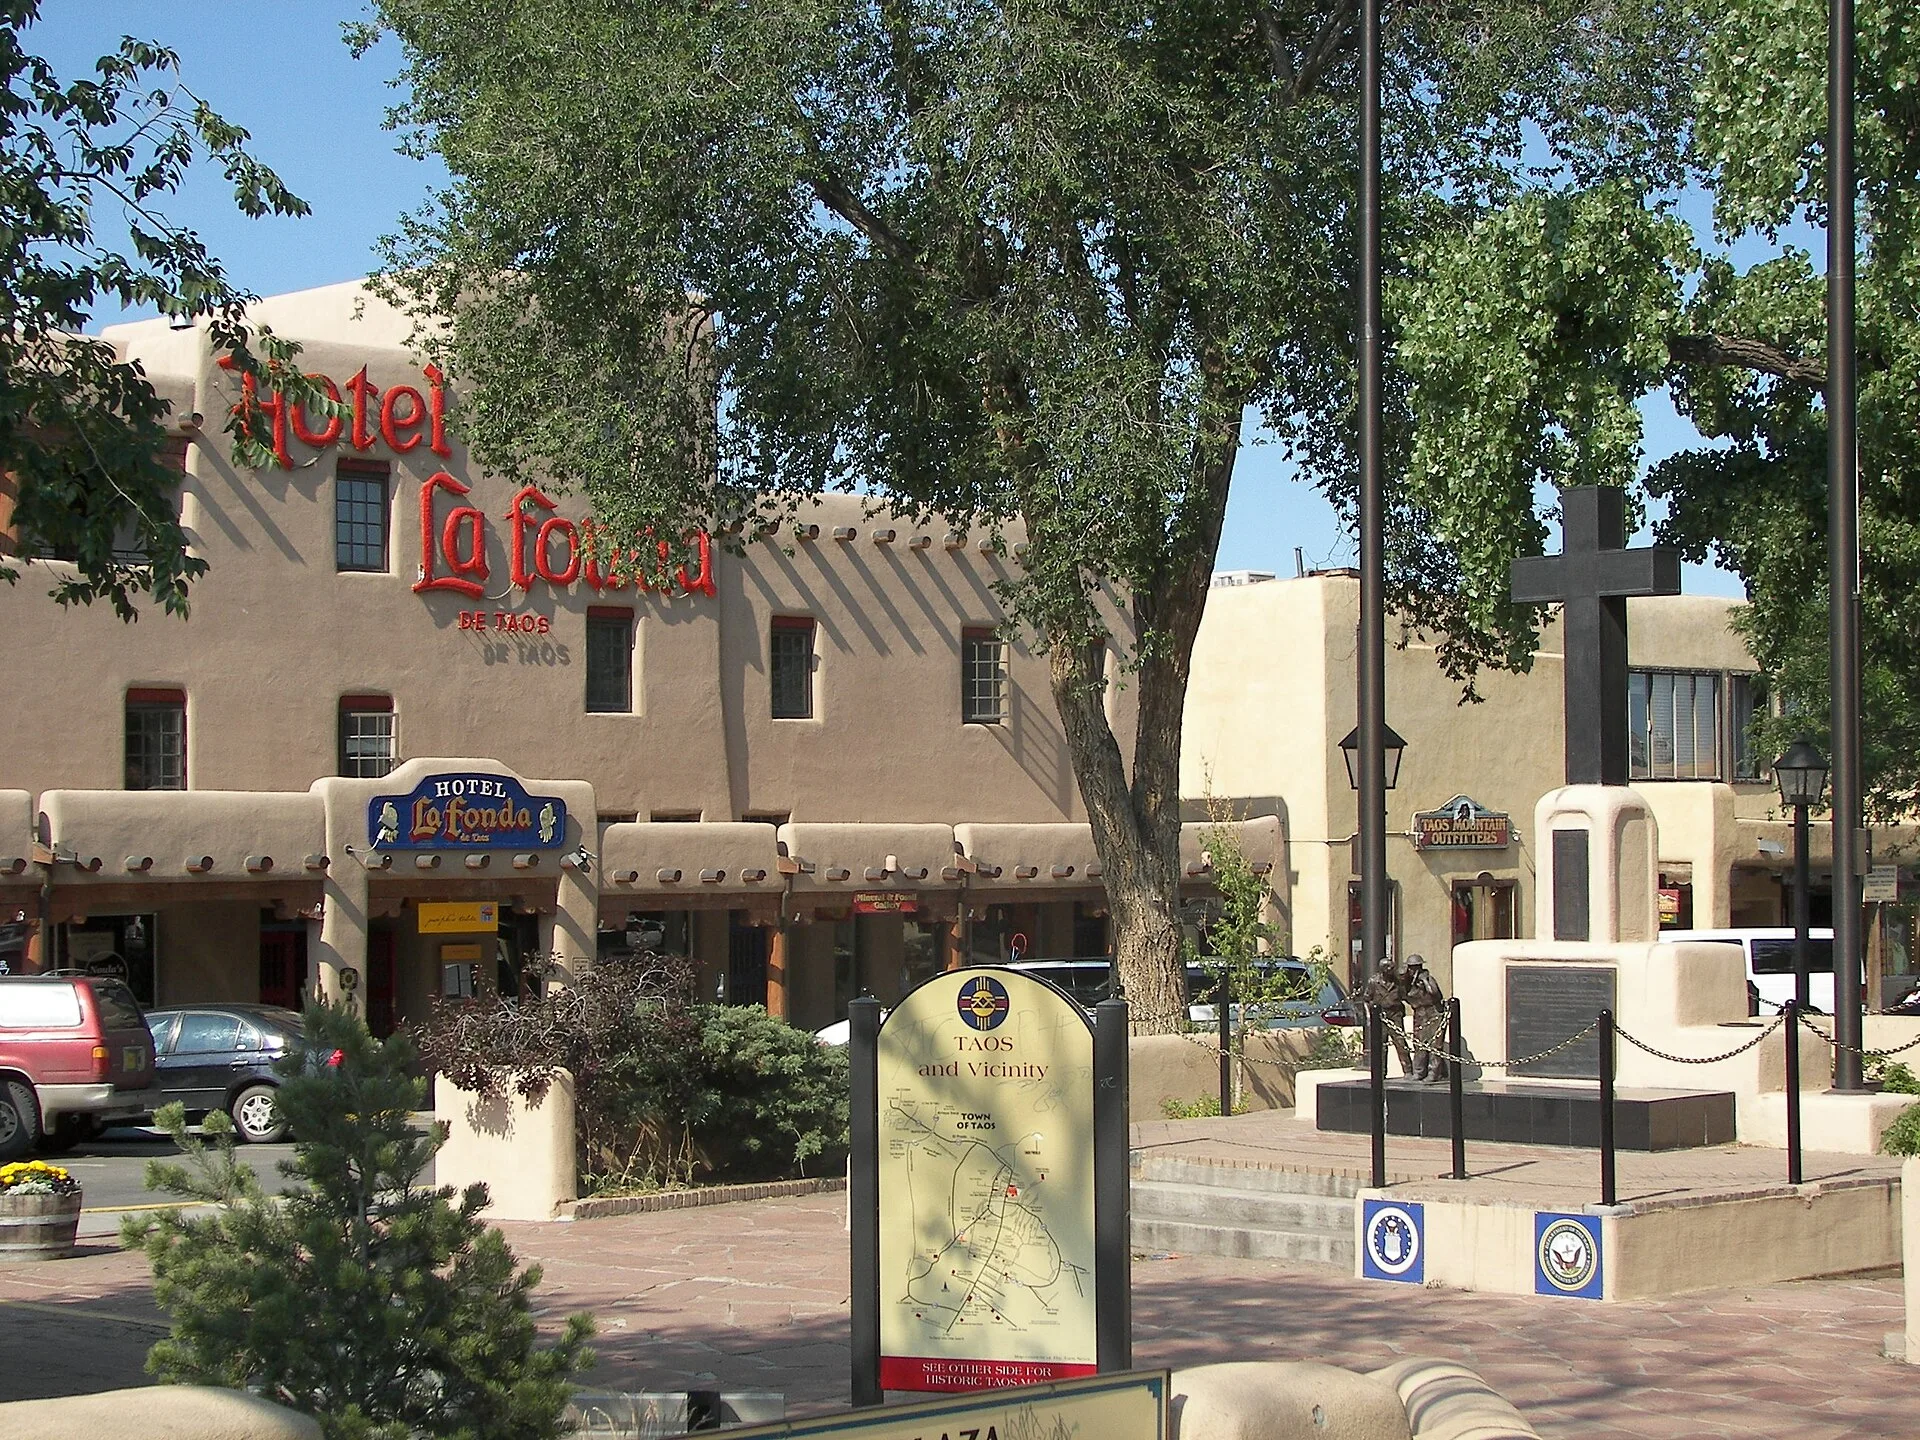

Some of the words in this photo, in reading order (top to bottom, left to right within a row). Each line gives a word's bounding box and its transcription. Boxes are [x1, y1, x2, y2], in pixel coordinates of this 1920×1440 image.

[216, 354, 453, 471] Hotel
[411, 471, 491, 600] La
[458, 610, 487, 631] DE
[494, 611, 550, 634] TAOS
[435, 779, 507, 798] HOTEL
[1421, 818, 1449, 832] TAOS
[1453, 817, 1507, 832] MOUNTAIN
[1431, 832, 1498, 845] OUTFITTERS
[856, 893, 885, 902] Mineral
[873, 901, 901, 910] Gallery
[953, 1036, 1013, 1052] TAOS
[918, 1061, 959, 1076] and
[967, 1061, 1049, 1081] Vicinity
[961, 1113, 991, 1121] TOWN
[956, 1122, 969, 1130] OF
[971, 1122, 996, 1130] TAOS
[922, 1362, 946, 1373] SEE
[949, 1363, 992, 1375] OTHER
[995, 1366, 1023, 1376] SIDE
[1026, 1367, 1052, 1377] FOR
[926, 1374, 983, 1386] HISTORIC
[986, 1376, 1018, 1387] TAOS
